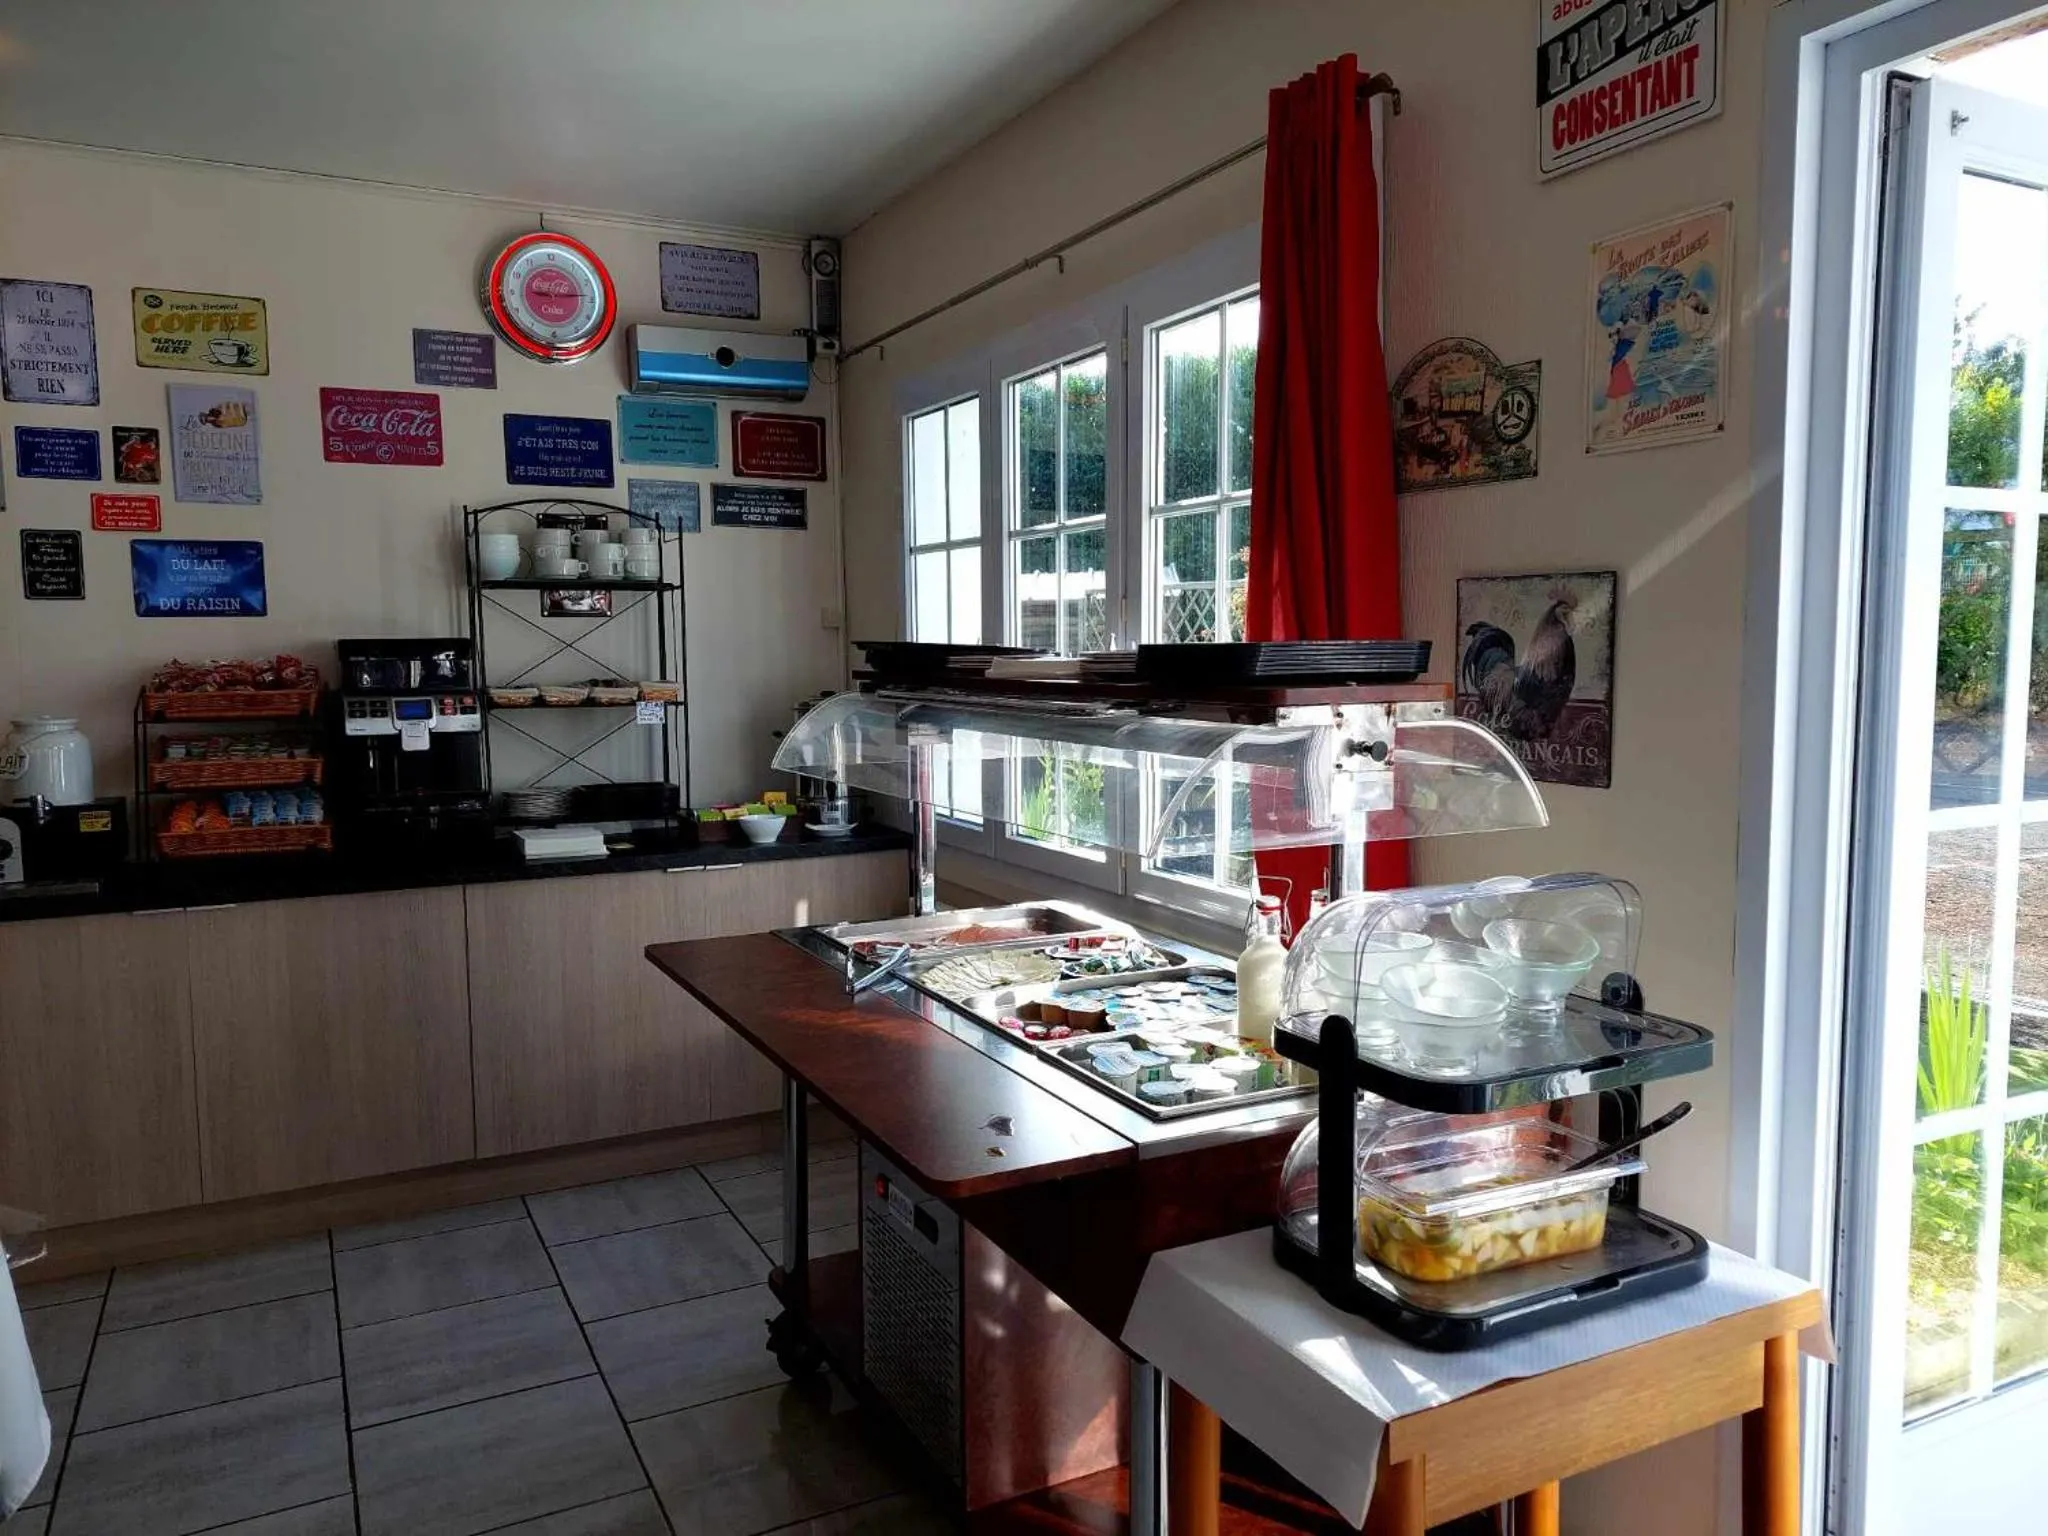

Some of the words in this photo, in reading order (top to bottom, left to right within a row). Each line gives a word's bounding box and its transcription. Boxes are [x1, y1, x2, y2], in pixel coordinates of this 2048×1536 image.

[1552, 44, 1700, 151] CONSENTANT
[36, 290, 54, 303] ICI
[141, 312, 258, 334] COFFEE
[154, 345, 189, 355] HERE
[10, 359, 89, 375] STRICTEMENT
[37, 378, 65, 394] RIEN
[171, 559, 189, 570] DU
[193, 559, 226, 571] LAIT
[159, 598, 180, 611] DU
[186, 598, 241, 611] RAISIN
